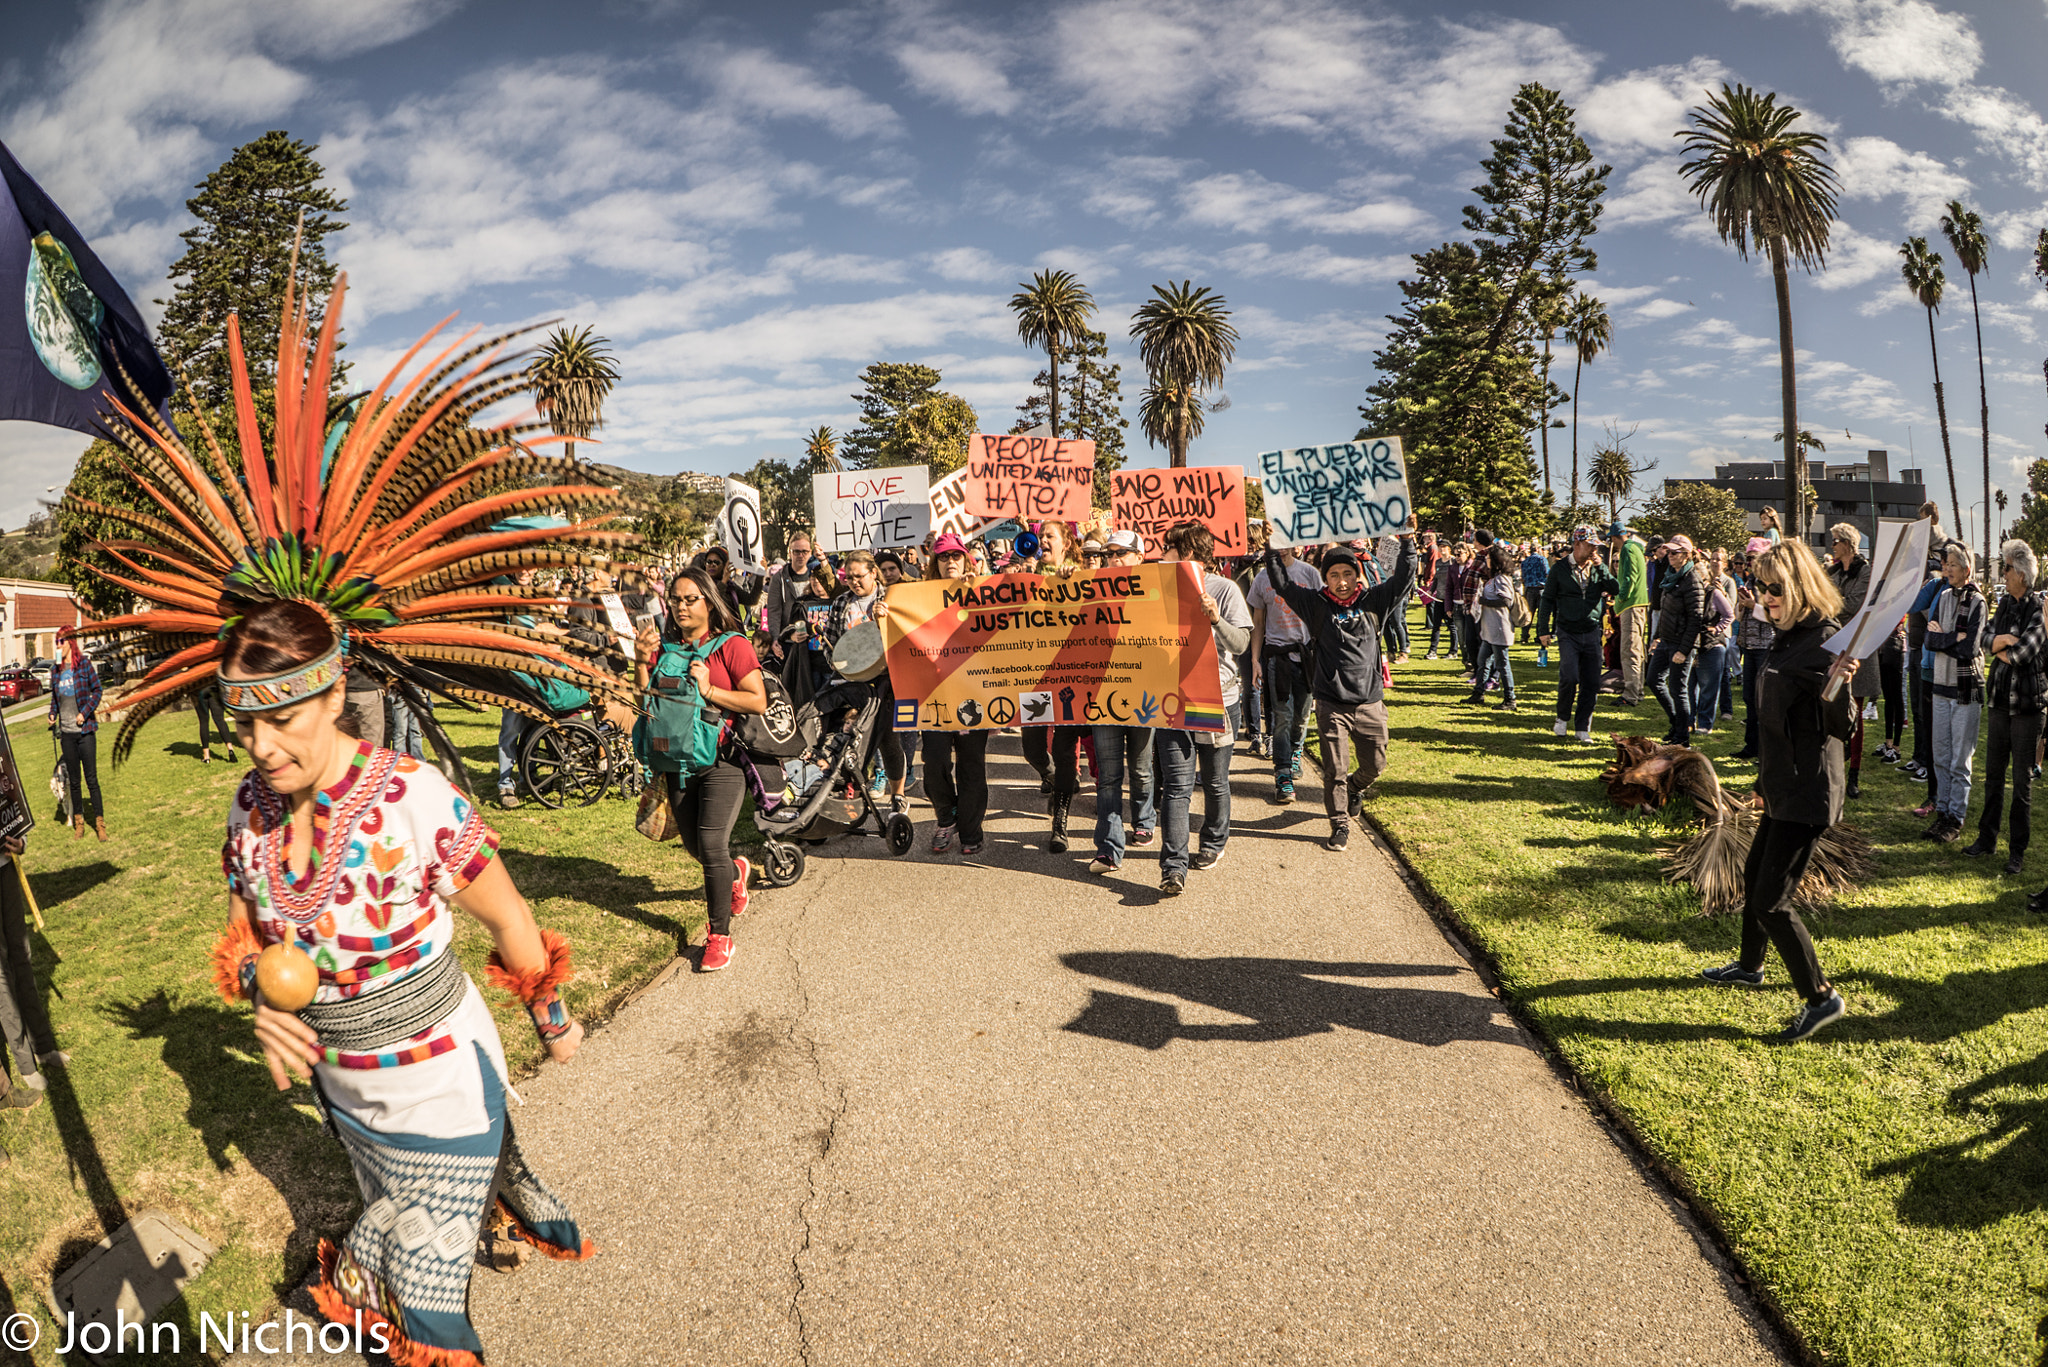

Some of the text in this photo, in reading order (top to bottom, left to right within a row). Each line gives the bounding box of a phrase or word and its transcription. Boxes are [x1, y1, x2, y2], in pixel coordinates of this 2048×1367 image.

[981, 435, 1075, 465] PEOPLE
[836, 474, 905, 499] LOVE
[971, 462, 1094, 486] UNITED AGAINST
[1265, 461, 1402, 495] UNIDO JAMAS
[853, 498, 890, 521] NOT
[1116, 500, 1155, 521] NOT
[1157, 497, 1216, 519] ALLOW
[1293, 485, 1366, 511] SERA
[1273, 495, 1406, 542] VENCIDO
[834, 516, 916, 551] HATE
[942, 575, 1145, 608] MARCH for JUSTICE
[969, 606, 1132, 633] JUSTICE for ALL
[909, 635, 1190, 658] Uniting our community in support of equal rights for all
[982, 674, 1133, 689] Email: JusticeForAllVC@gmail.com
[1, 800, 21, 825] ONE
